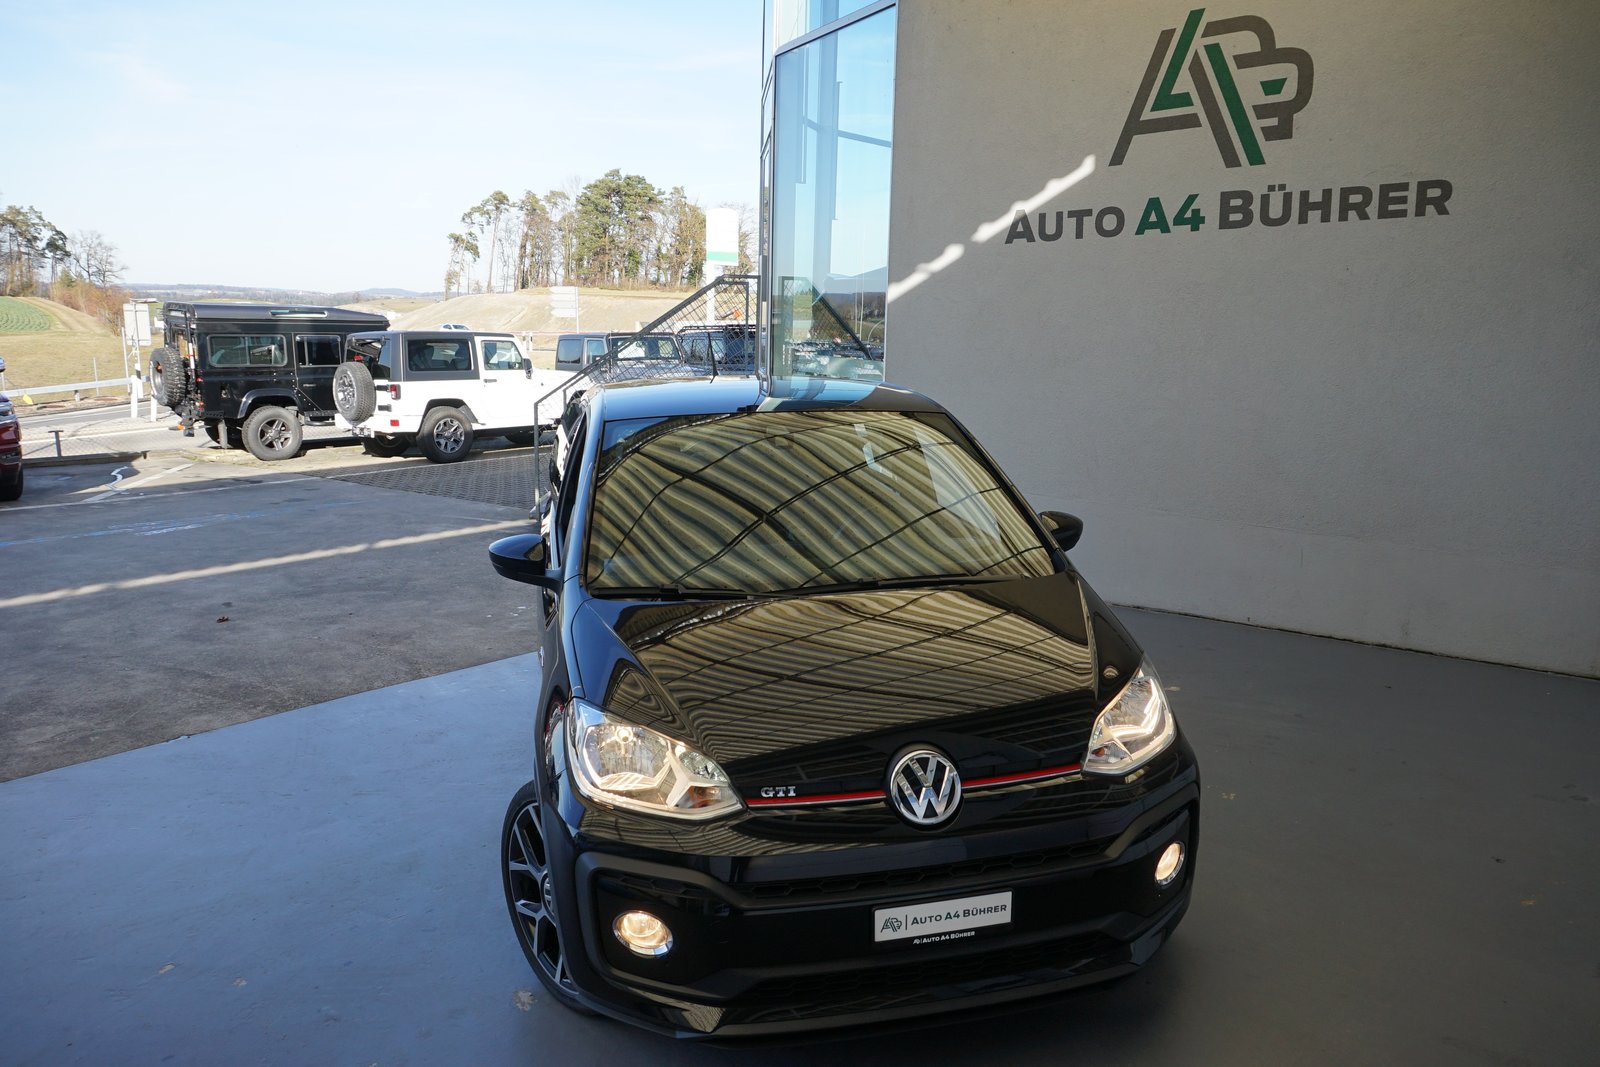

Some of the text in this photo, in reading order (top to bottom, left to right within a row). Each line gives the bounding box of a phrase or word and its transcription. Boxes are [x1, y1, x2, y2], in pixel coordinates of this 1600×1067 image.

[1004, 179, 1453, 244] AUTO A4 BÜHRER
[760, 786, 796, 798] GTI
[896, 754, 958, 820] VW
[911, 904, 1008, 926] AUTO A4 BÜHRER
[922, 936, 940, 944] AUTO
[950, 931, 976, 940] BÜHRER
